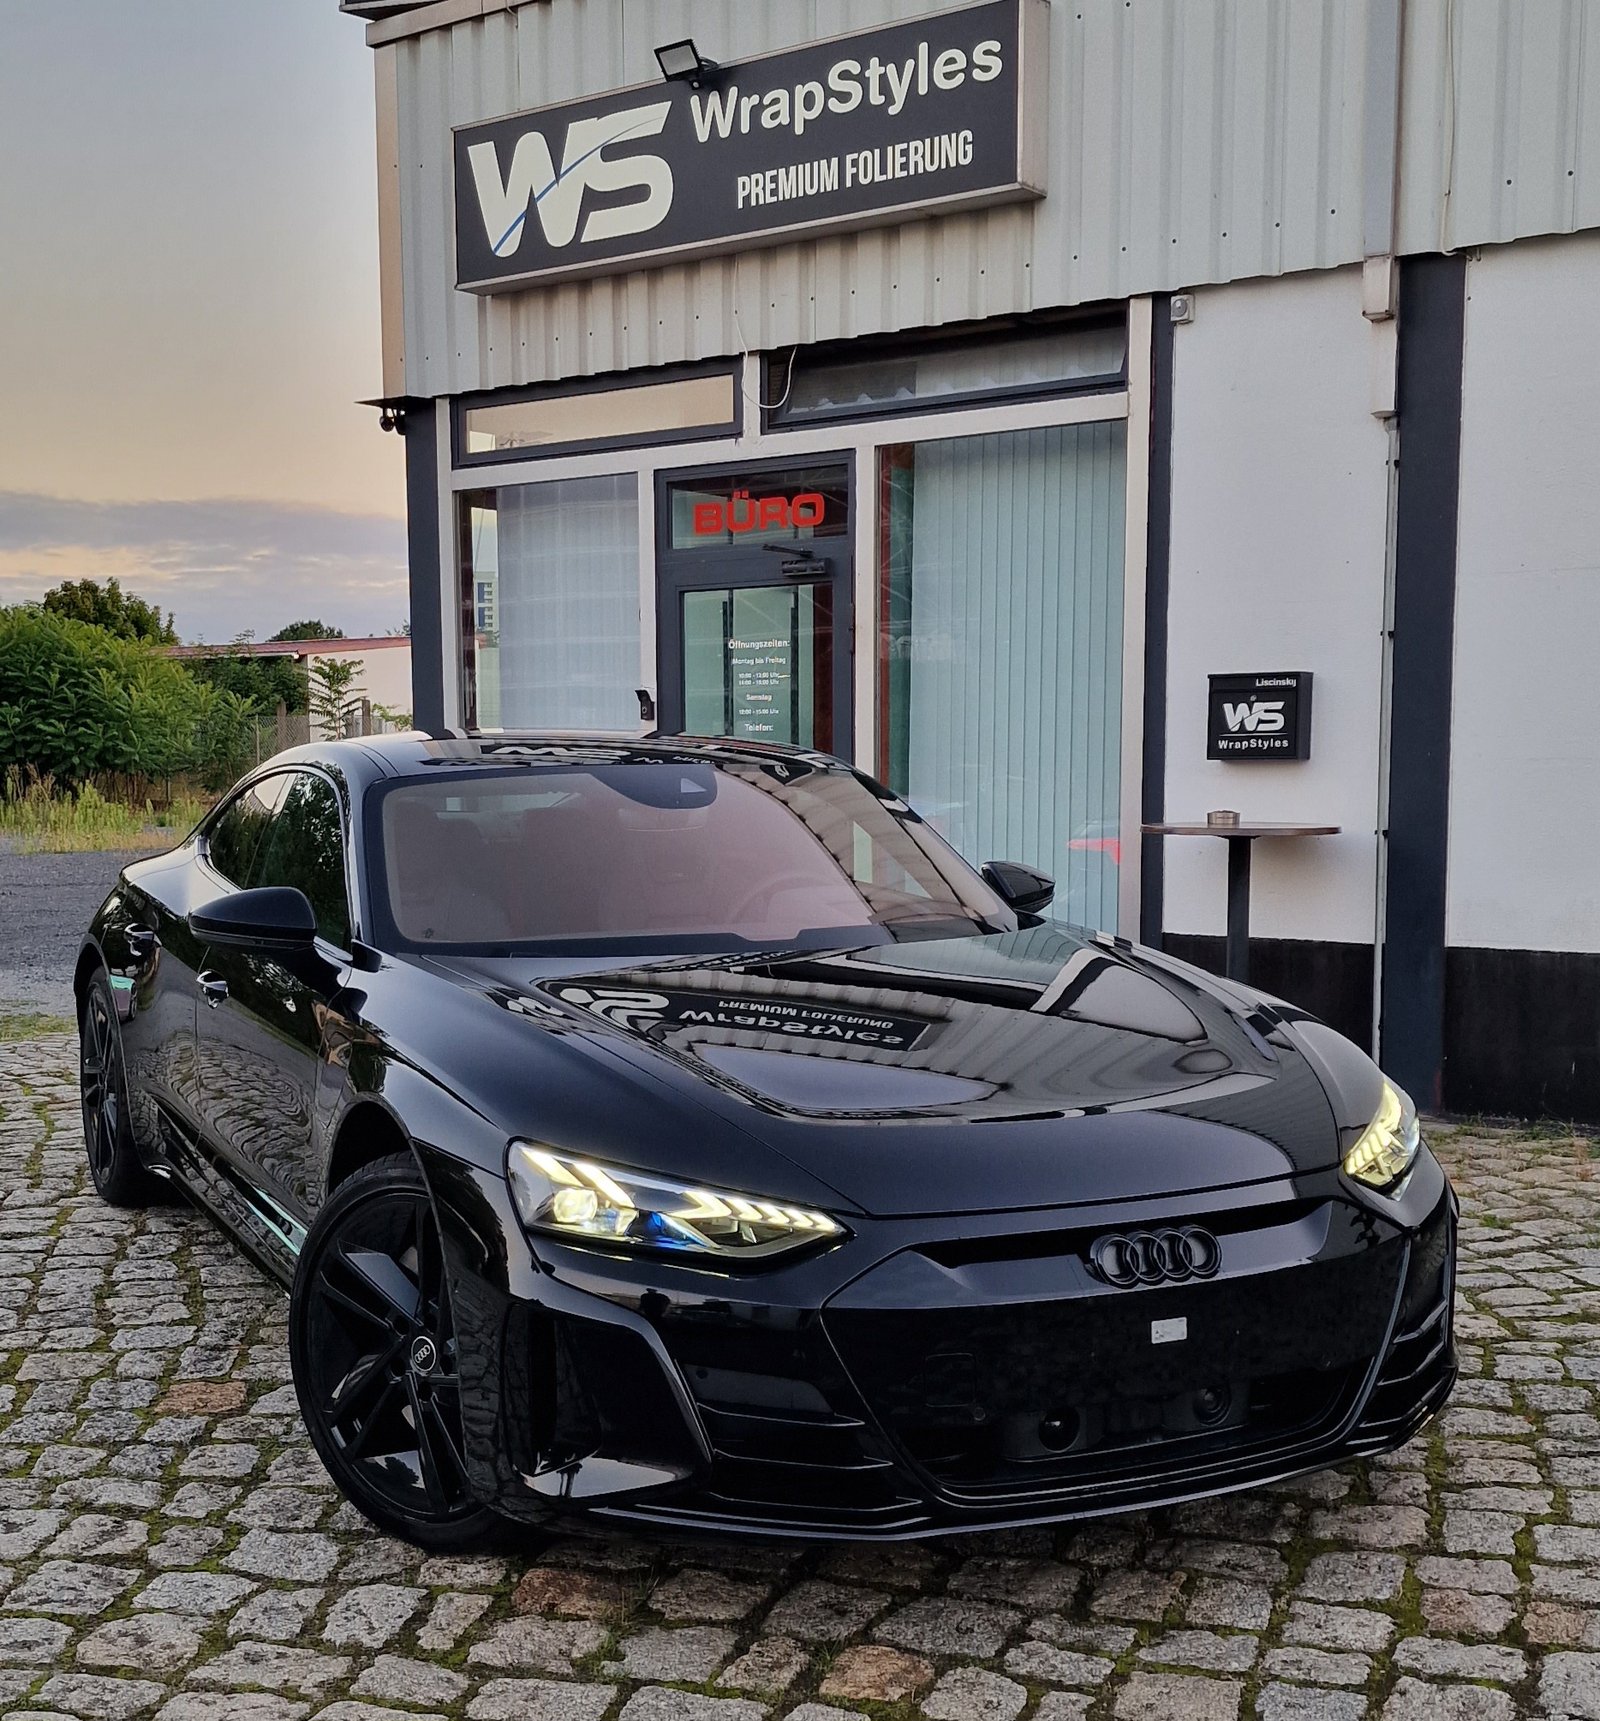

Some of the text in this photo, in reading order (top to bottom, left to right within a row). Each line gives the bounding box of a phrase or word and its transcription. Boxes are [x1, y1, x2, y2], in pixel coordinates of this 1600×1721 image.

[690, 40, 1004, 142] WrapStyles
[737, 129, 974, 209] PREMIUM FOLIERUNG
[468, 101, 674, 257] WS
[693, 490, 825, 535] BÜRO
[728, 638, 791, 650] Öffnungszeiten:
[732, 657, 754, 666] Montag
[765, 656, 786, 665] Freitag
[1255, 677, 1297, 687] Liscinsky
[746, 694, 772, 702] Samstag
[1222, 701, 1285, 733] WS
[744, 723, 774, 732] Telefon:
[1218, 738, 1289, 750] WrapStyles
